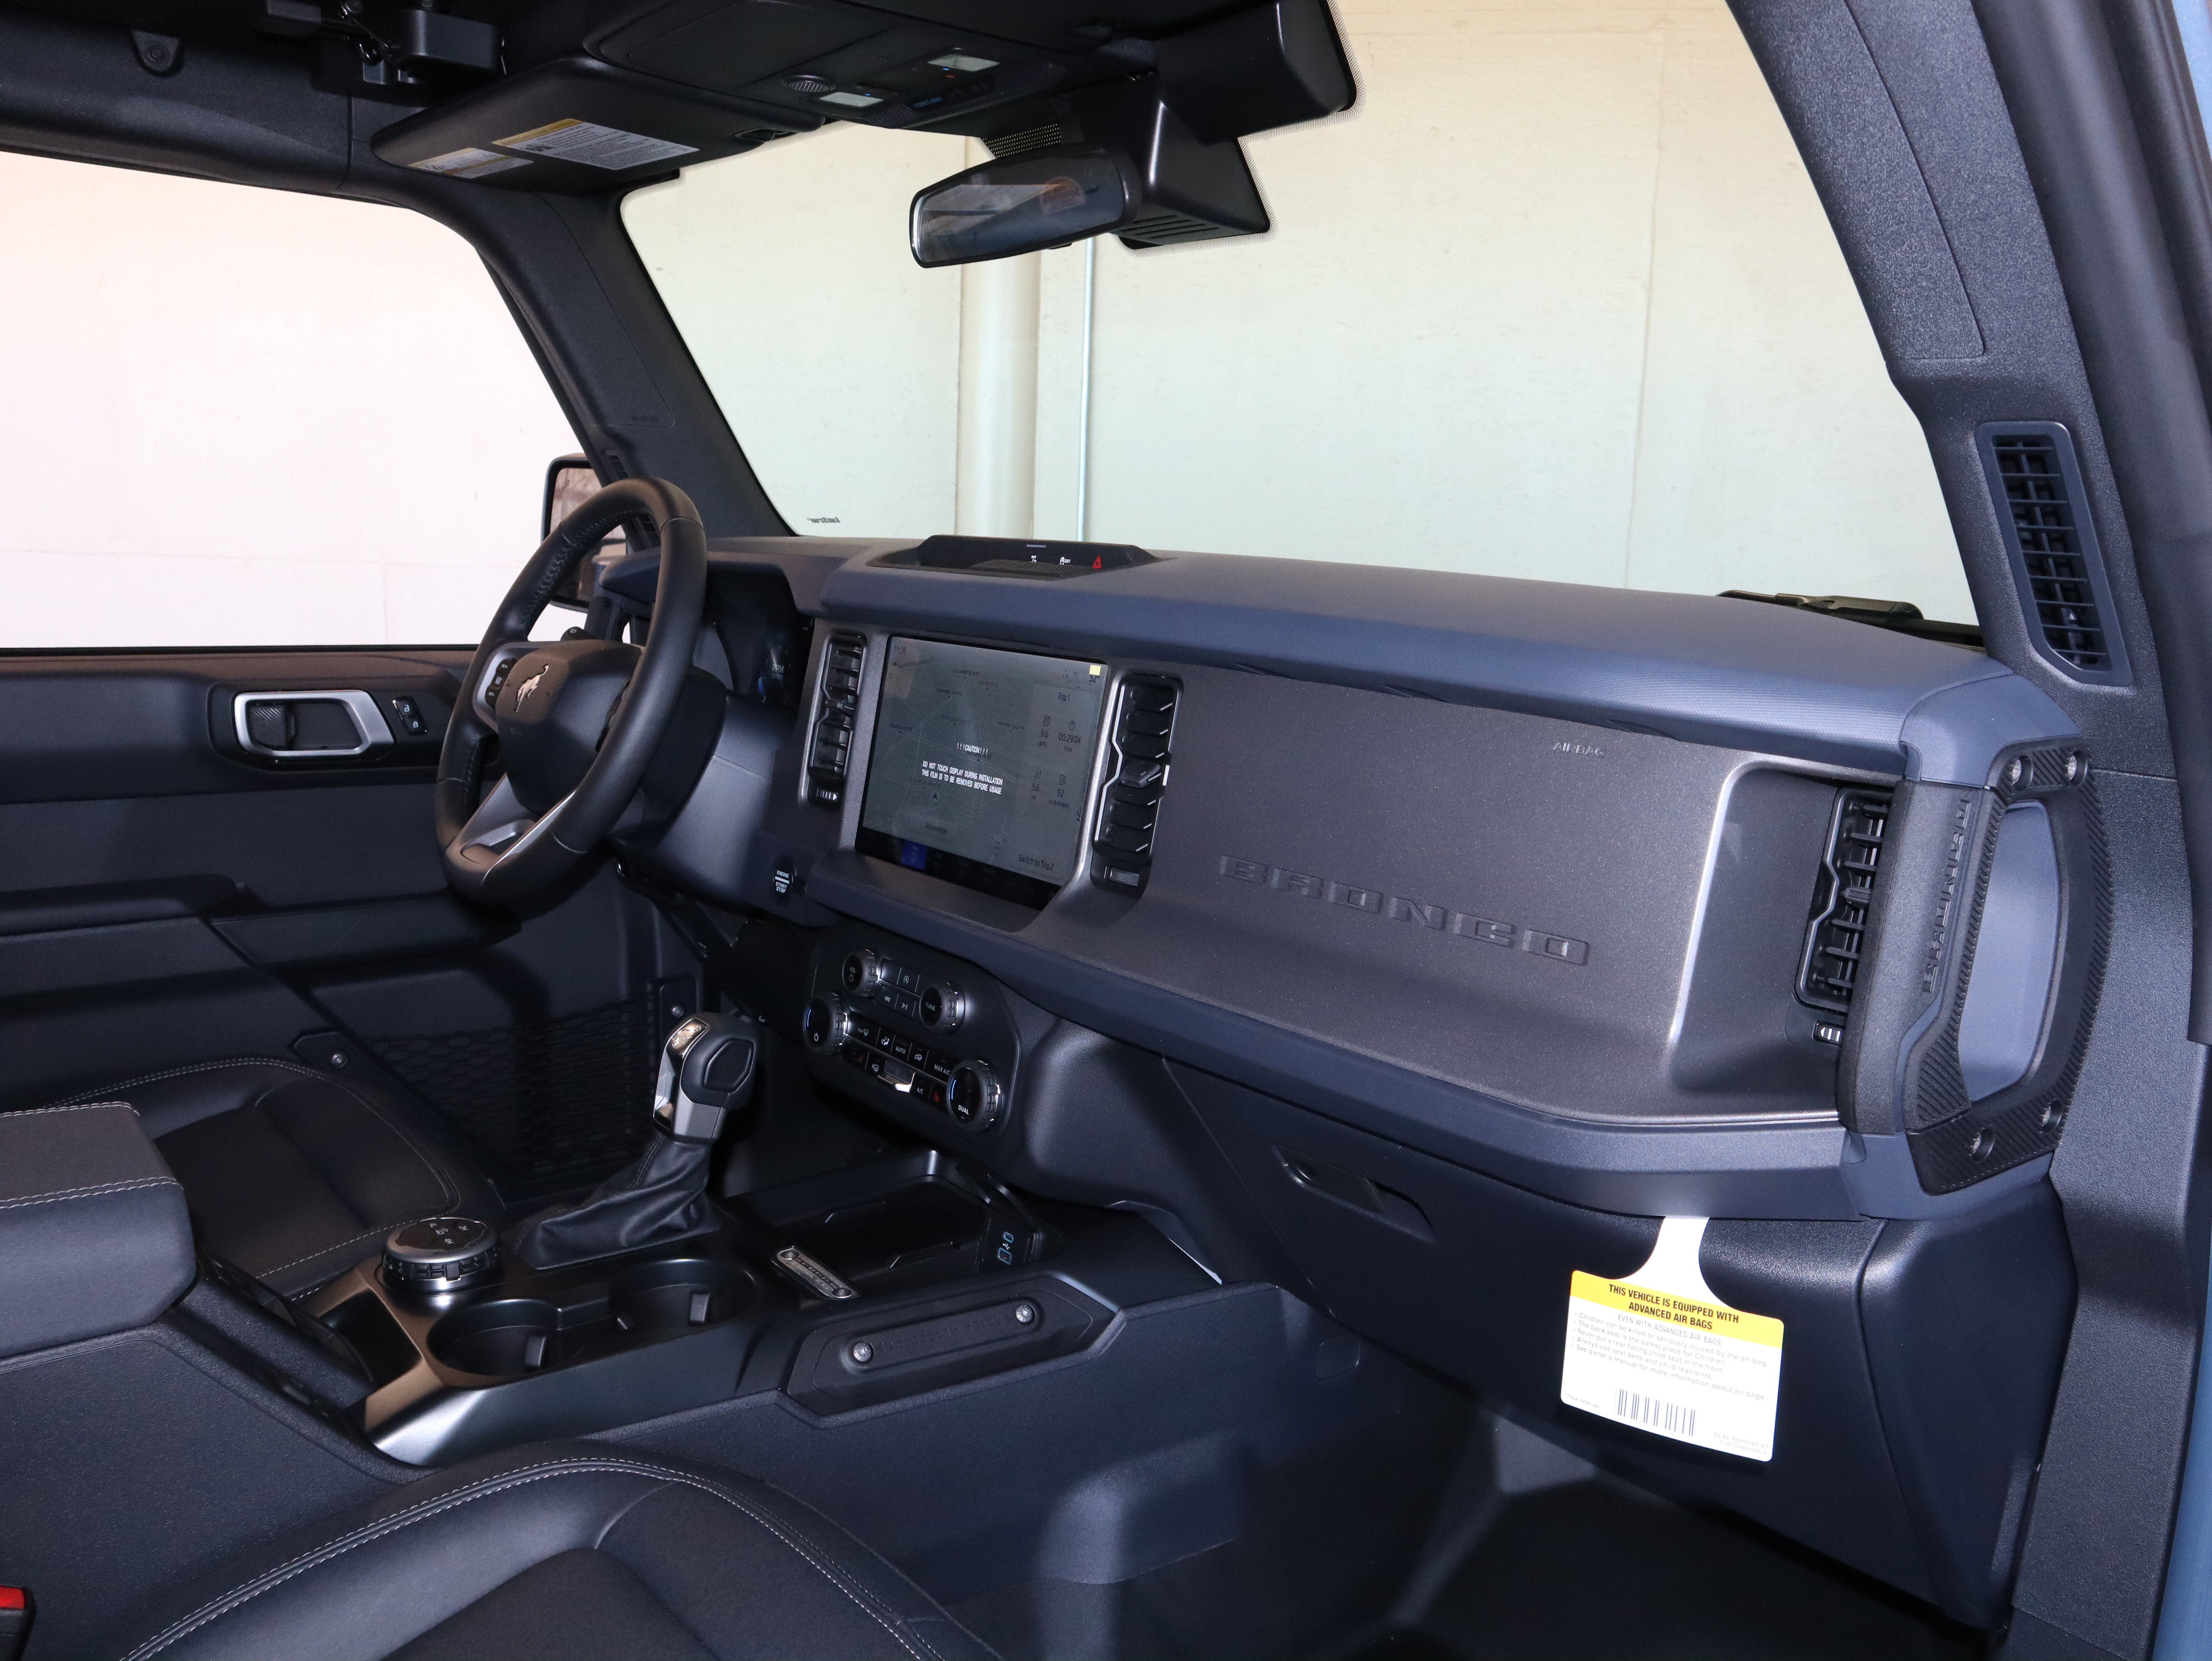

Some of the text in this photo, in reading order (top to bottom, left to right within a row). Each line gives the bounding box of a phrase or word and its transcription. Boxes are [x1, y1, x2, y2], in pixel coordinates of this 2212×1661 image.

[1058, 692, 1067, 701] Trip
[1552, 742, 1606, 758] AIRBAG
[937, 764, 949, 772] TOUCH
[949, 767, 964, 776] DISPLAY
[964, 771, 977, 779] DURING
[979, 774, 1003, 785] INSTALLATION
[956, 777, 973, 787] REMOVED
[974, 782, 989, 791] BEFORE
[990, 785, 1002, 794] USAGE
[1057, 789, 1064, 797] 52
[1018, 854, 1034, 865] Switch
[1041, 860, 1050, 871] Trip
[1219, 855, 1590, 966] BRONCO
[926, 1002, 935, 1011] TUNE
[896, 1046, 905, 1054] AUTO
[934, 1064, 943, 1074] MAX
[958, 1105, 969, 1115] DUAL
[1609, 1284, 1739, 1323] THIS VEHICLE IS EQUIPPED WITH
[1628, 1302, 1713, 1330] ADVANCED AIR BAGS
[1618, 1314, 1633, 1324] EVEN
[1636, 1318, 1652, 1329] WITH
[1654, 1324, 1687, 1338] ADVANCED
[1704, 1336, 1721, 1346] BAGS
[1579, 1312, 1604, 1325] Children
[1628, 1328, 1645, 1337] killed
[1657, 1335, 1688, 1348] seriously
[1690, 1345, 1714, 1354] injured
[1717, 1350, 1725, 1358] by
[1753, 1358, 1768, 1367] bag.
[1579, 1320, 1589, 1328] The
[1591, 1325, 1605, 1333] back
[1608, 1330, 1620, 1338] seat
[1641, 1340, 1661, 1349] safest
[1663, 1345, 1681, 1354] place
[1695, 1353, 1727, 1366] Children.
[1577, 1336, 1598, 1348] Always
[1628, 1352, 1643, 1361] belts
[1659, 1361, 1676, 1370] child
[1678, 1367, 1713, 1380] restraints.
[1578, 1328, 1594, 1338] Never
[1628, 1344, 1647, 1355] facing
[1649, 1350, 1665, 1359] child
[1706, 1364, 1724, 1374] front.
[1589, 1350, 1612, 1360] owner's
[1614, 1357, 1637, 1368] manual
[1650, 1367, 1667, 1377] more
[1669, 1372, 1709, 1387] information
[1712, 1384, 1732, 1393] about
[1746, 1390, 1766, 1401] bags.
[1719, 1441, 1750, 1451] CUSTOMER
[1732, 1437, 1759, 1447] REMOVED
